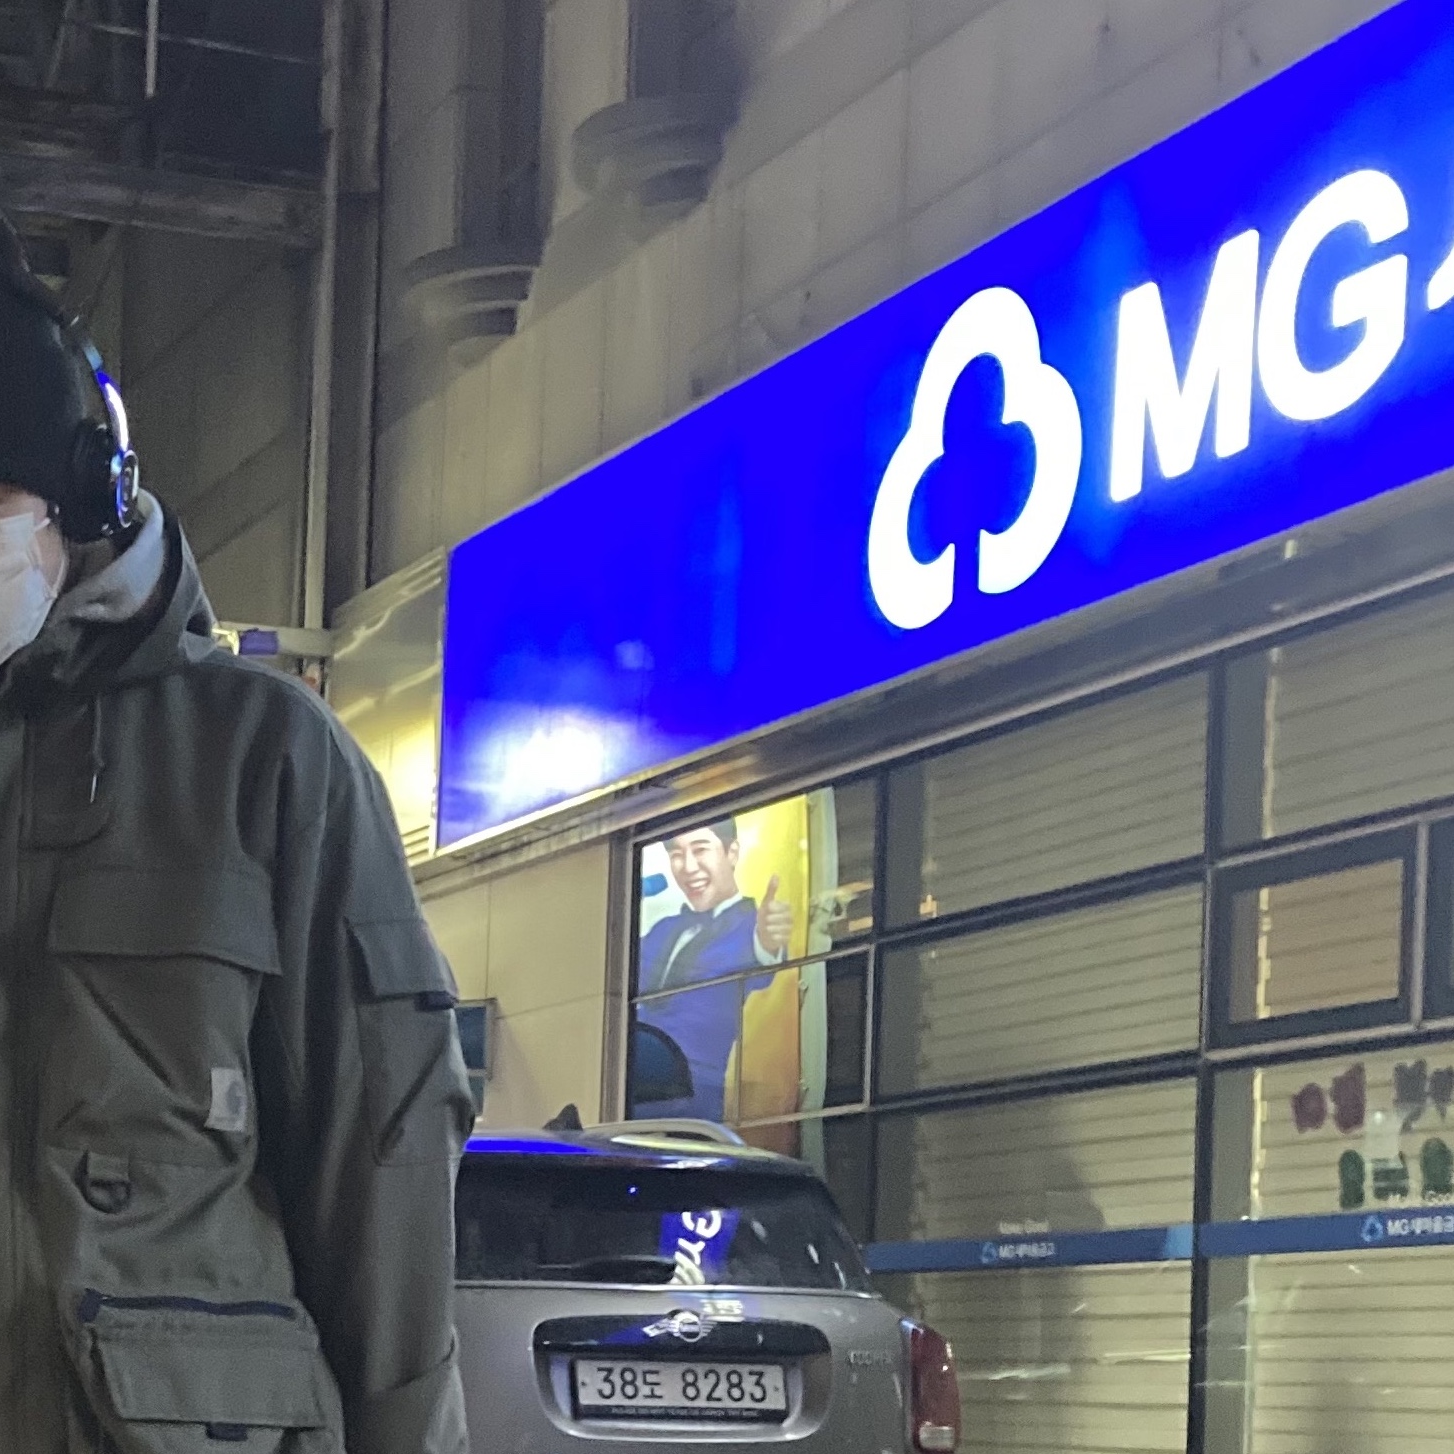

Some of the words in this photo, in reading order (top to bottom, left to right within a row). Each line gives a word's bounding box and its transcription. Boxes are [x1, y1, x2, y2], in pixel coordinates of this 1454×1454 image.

[1110, 168, 1454, 504] MG
[596, 1366, 664, 1400] 38도
[681, 1368, 768, 1403] 8283
